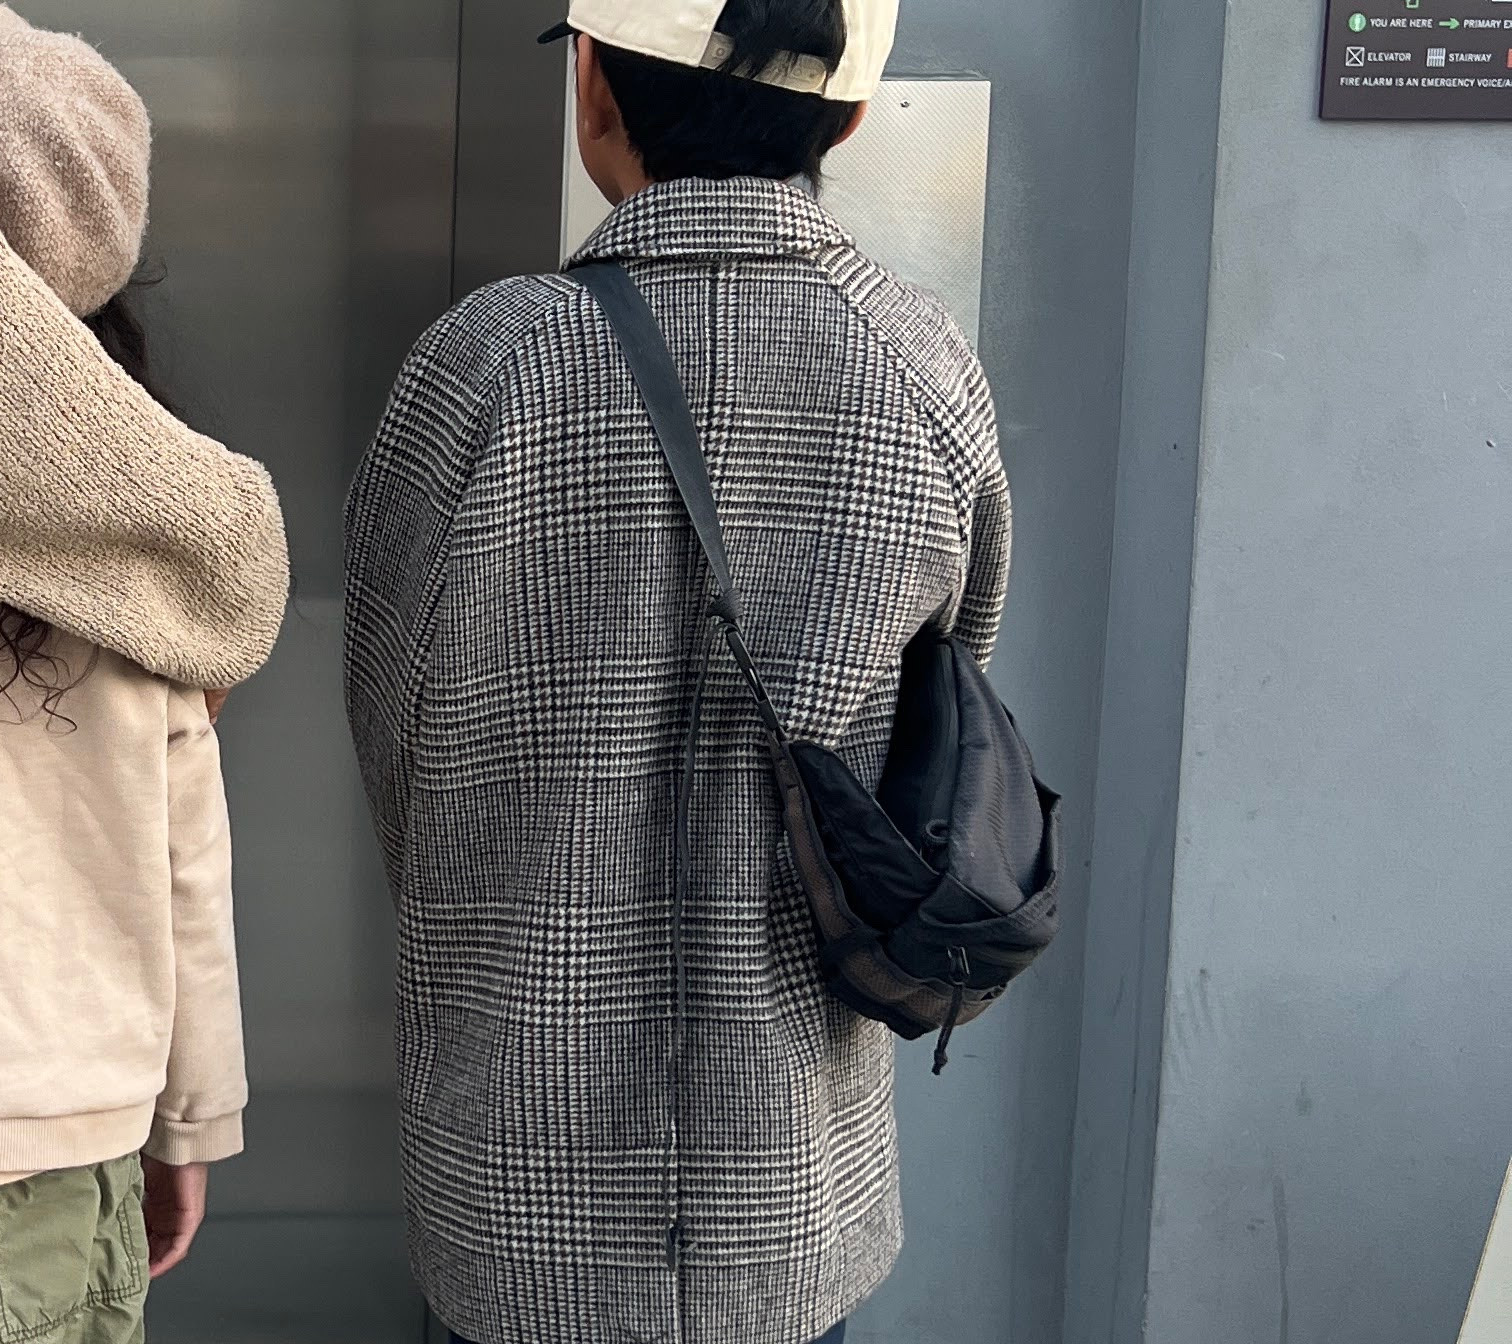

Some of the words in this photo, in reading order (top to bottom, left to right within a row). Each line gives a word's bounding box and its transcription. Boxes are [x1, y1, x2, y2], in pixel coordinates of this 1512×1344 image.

[1370, 18, 1388, 27] YOU
[1389, 18, 1407, 28] ARE
[1409, 18, 1433, 28] HERE
[1463, 19, 1501, 29] PRIMARY
[1367, 52, 1412, 62] ELEVATOR
[1448, 53, 1492, 62] STAIRWAY
[1340, 77, 1360, 86] FIRE
[1362, 77, 1393, 87] ALARM
[1395, 78, 1404, 87] IS
[1406, 78, 1419, 87] AN
[1421, 78, 1475, 88] EMERGENCY
